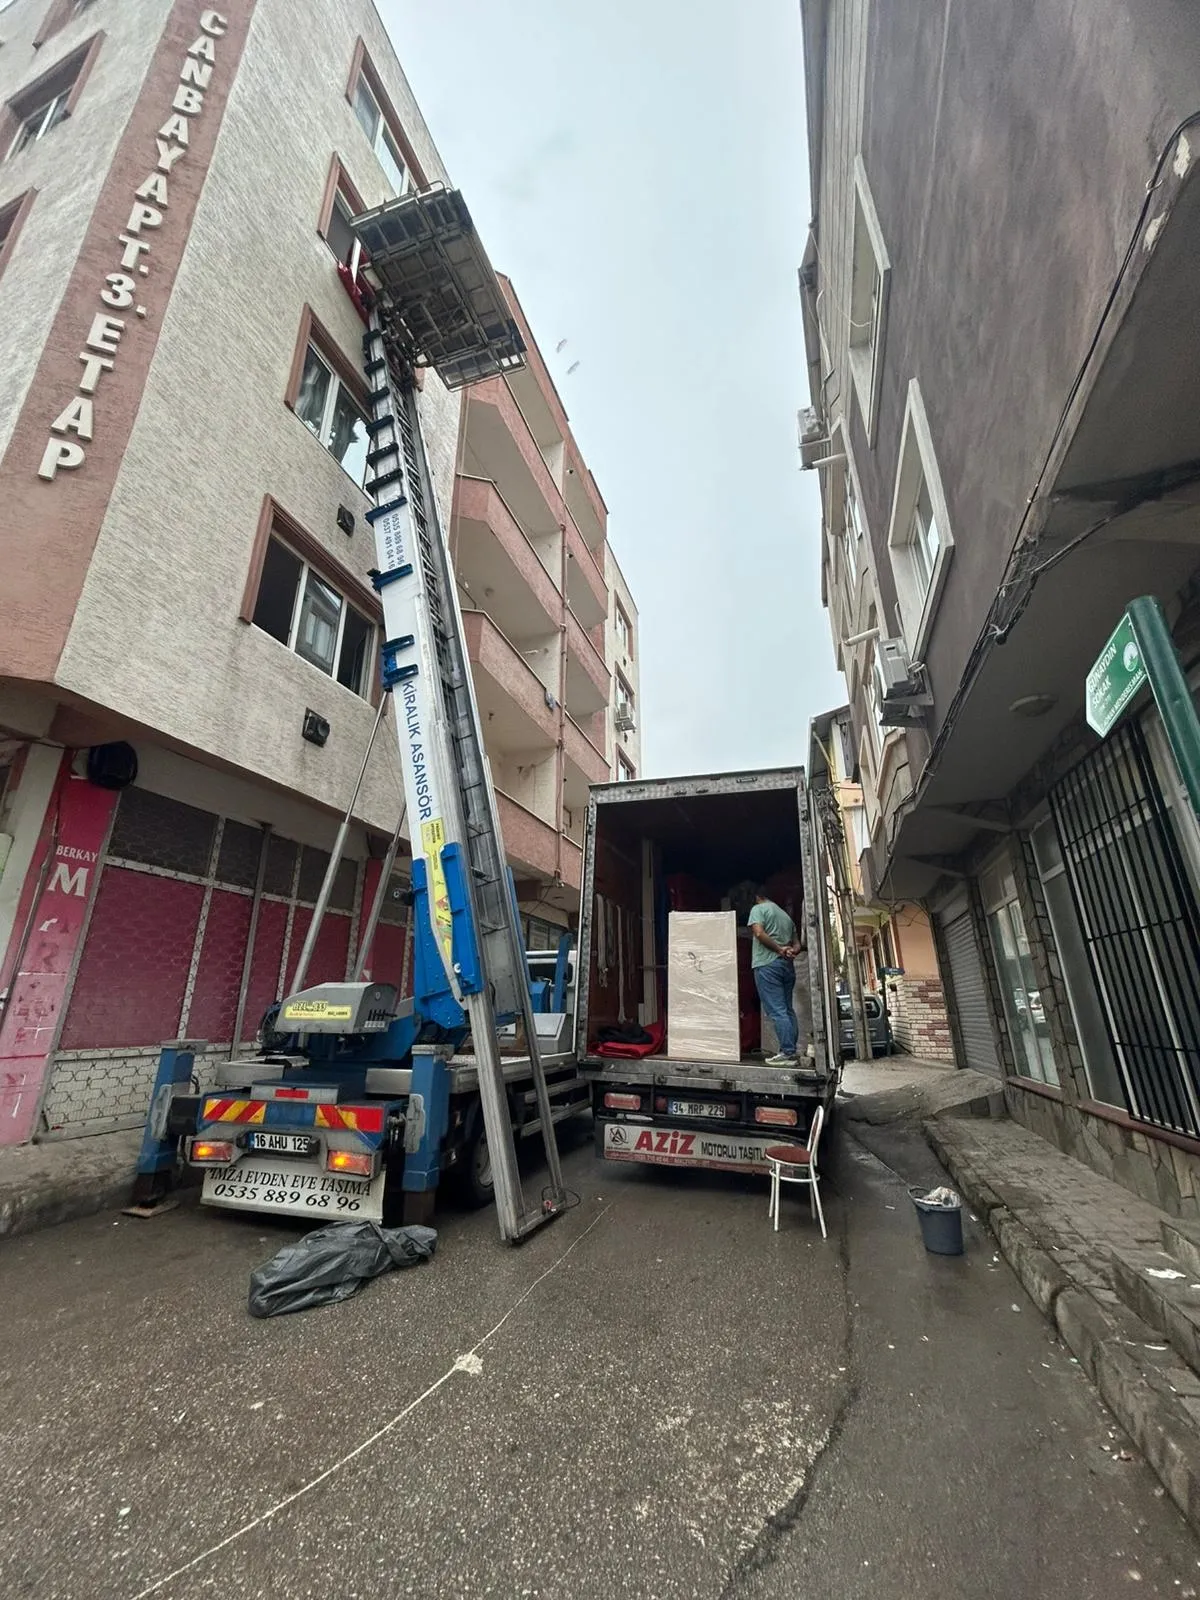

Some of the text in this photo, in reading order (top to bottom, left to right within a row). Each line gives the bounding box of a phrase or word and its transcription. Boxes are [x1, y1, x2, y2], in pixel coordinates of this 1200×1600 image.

[37, 9, 227, 481] CANBAY APT. 3. ETAP
[403, 680, 421, 739] KİRALIK
[410, 743, 433, 821] ASANSÖR
[56, 844, 99, 863] BERKAY
[673, 1102, 684, 1114] 34
[708, 1105, 725, 1117] 229
[255, 1134, 309, 1151] 16 AHU 125
[701, 1142, 737, 1159] MOTORLU
[214, 1183, 361, 1211] 0535 889 68 96
[244, 1171, 289, 1188] EVDEN
[290, 1175, 318, 1190] EVE
[320, 1178, 372, 1197] TAŞIMA
